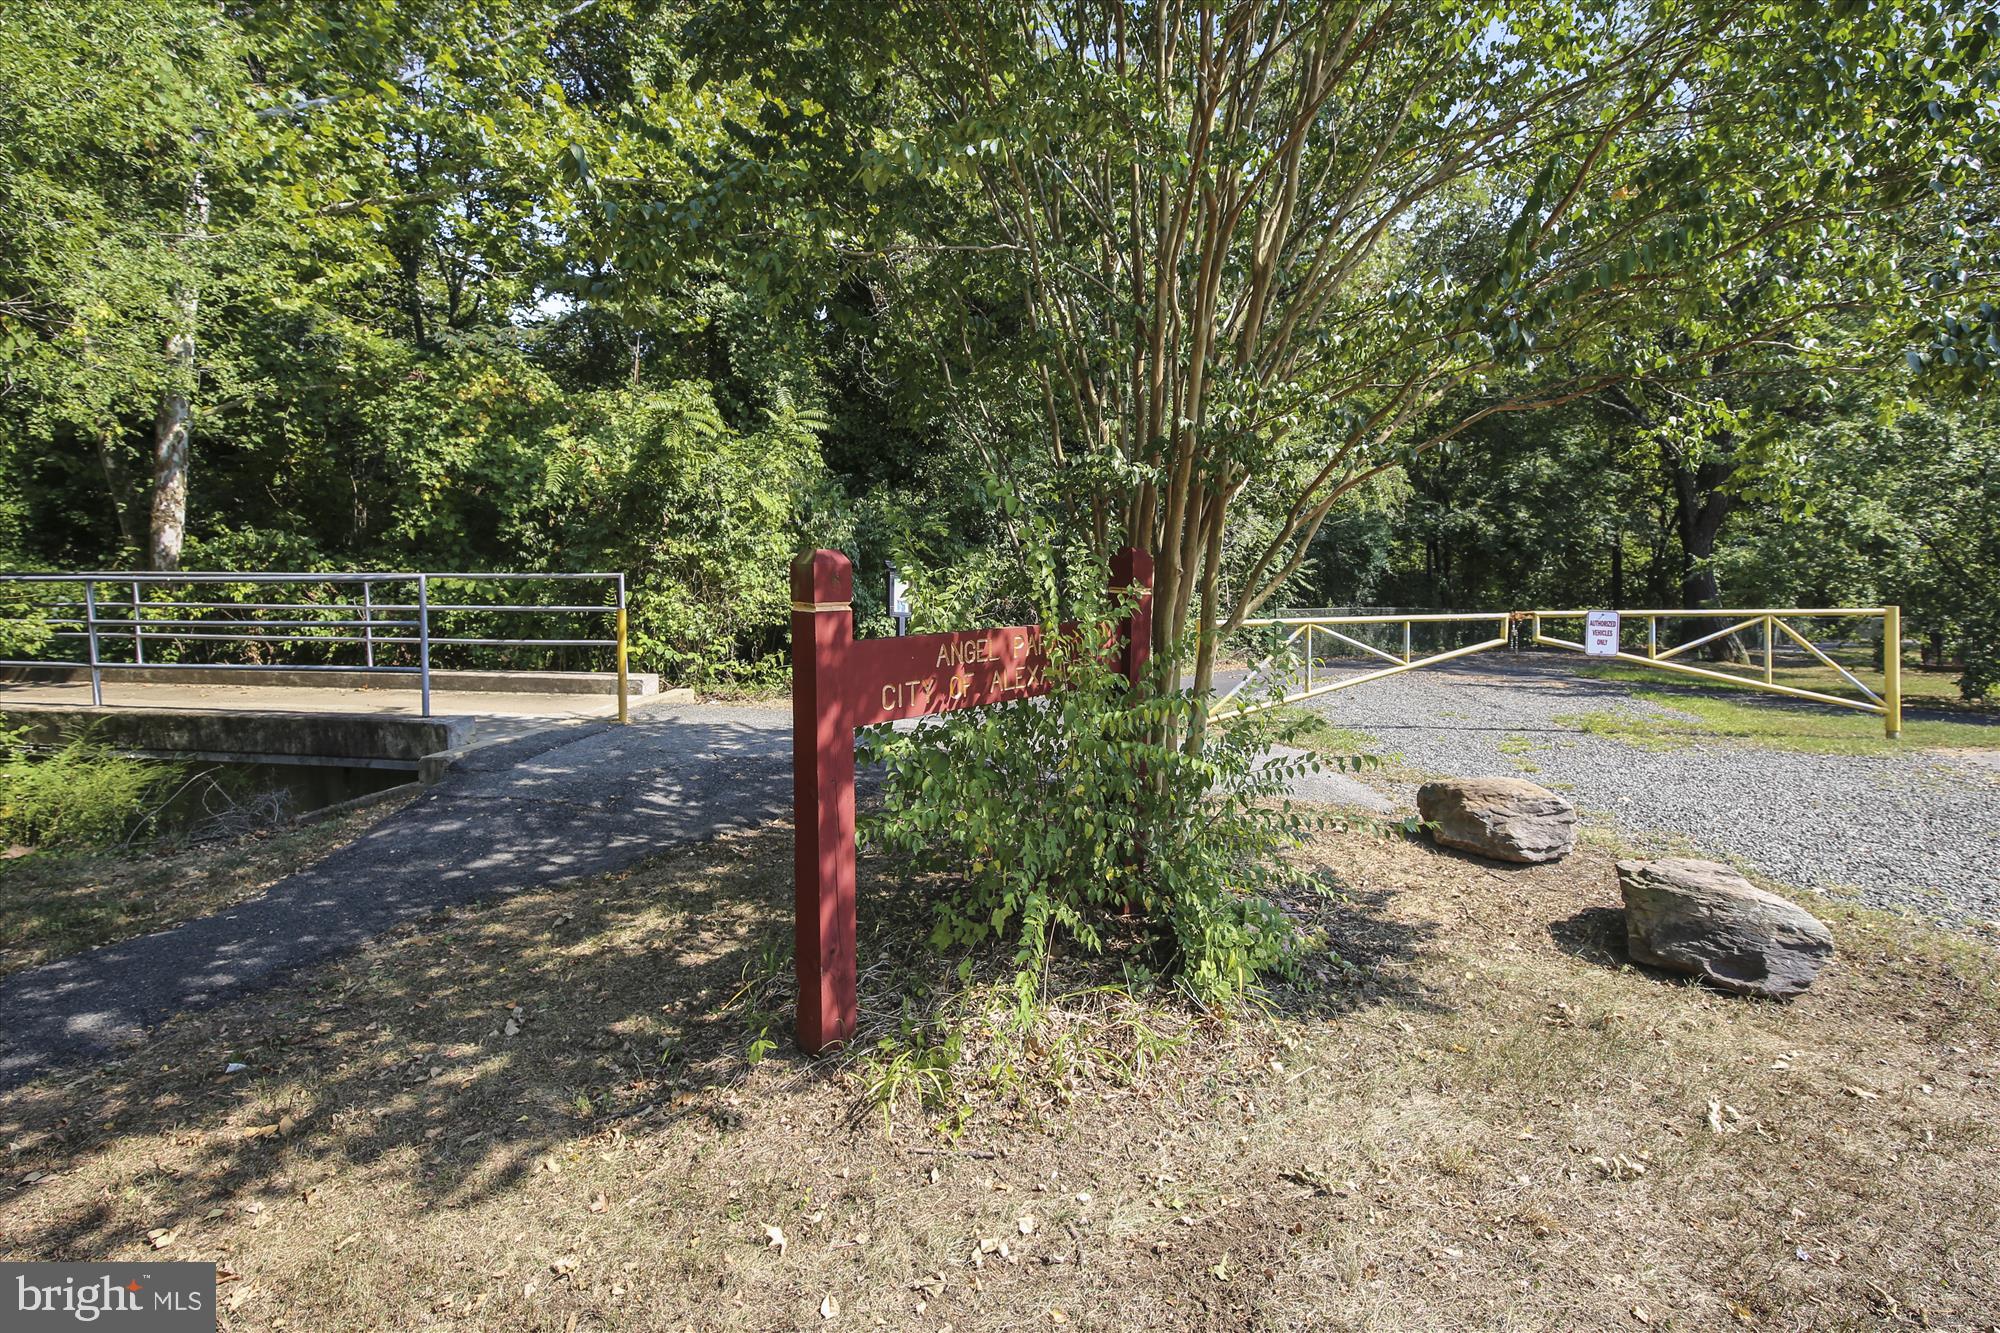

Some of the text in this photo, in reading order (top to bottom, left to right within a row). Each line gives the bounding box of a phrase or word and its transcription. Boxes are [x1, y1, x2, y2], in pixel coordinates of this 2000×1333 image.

[936, 639, 1000, 668] ANGEL
[882, 677, 936, 711] CITY
[949, 672, 975, 700] OF
